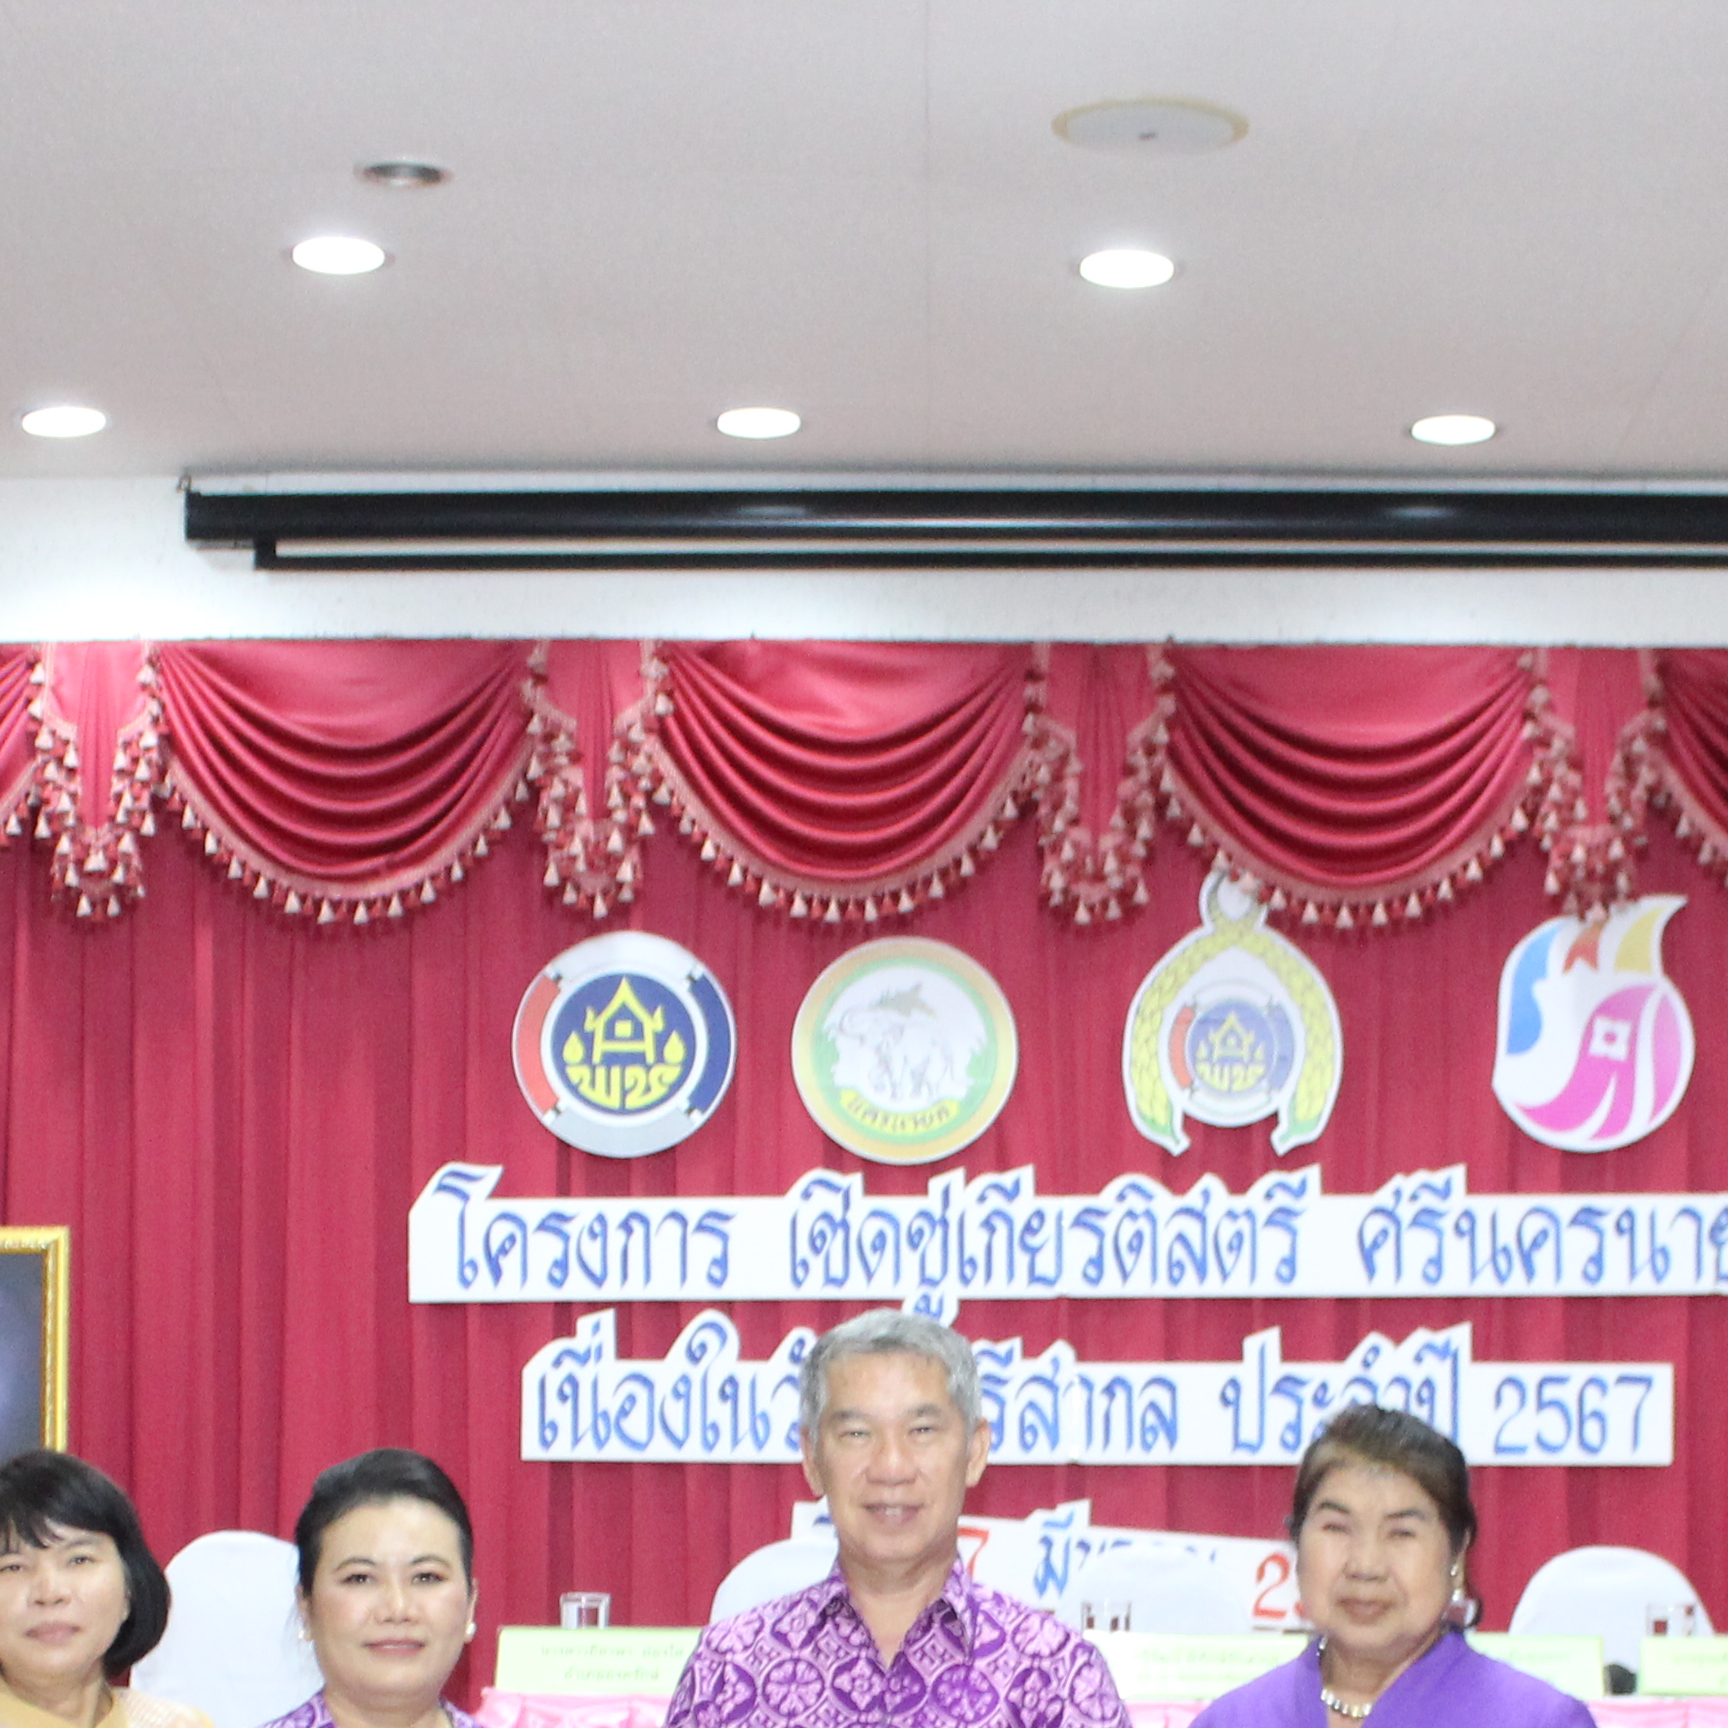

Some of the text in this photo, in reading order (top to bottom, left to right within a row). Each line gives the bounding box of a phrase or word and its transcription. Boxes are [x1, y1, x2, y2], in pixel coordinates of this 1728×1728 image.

[433, 1168, 738, 1289] โครงการ
[790, 1172, 1308, 1319] เชิดชูเกียรติสตรี
[1493, 1374, 1654, 1456] 2567
